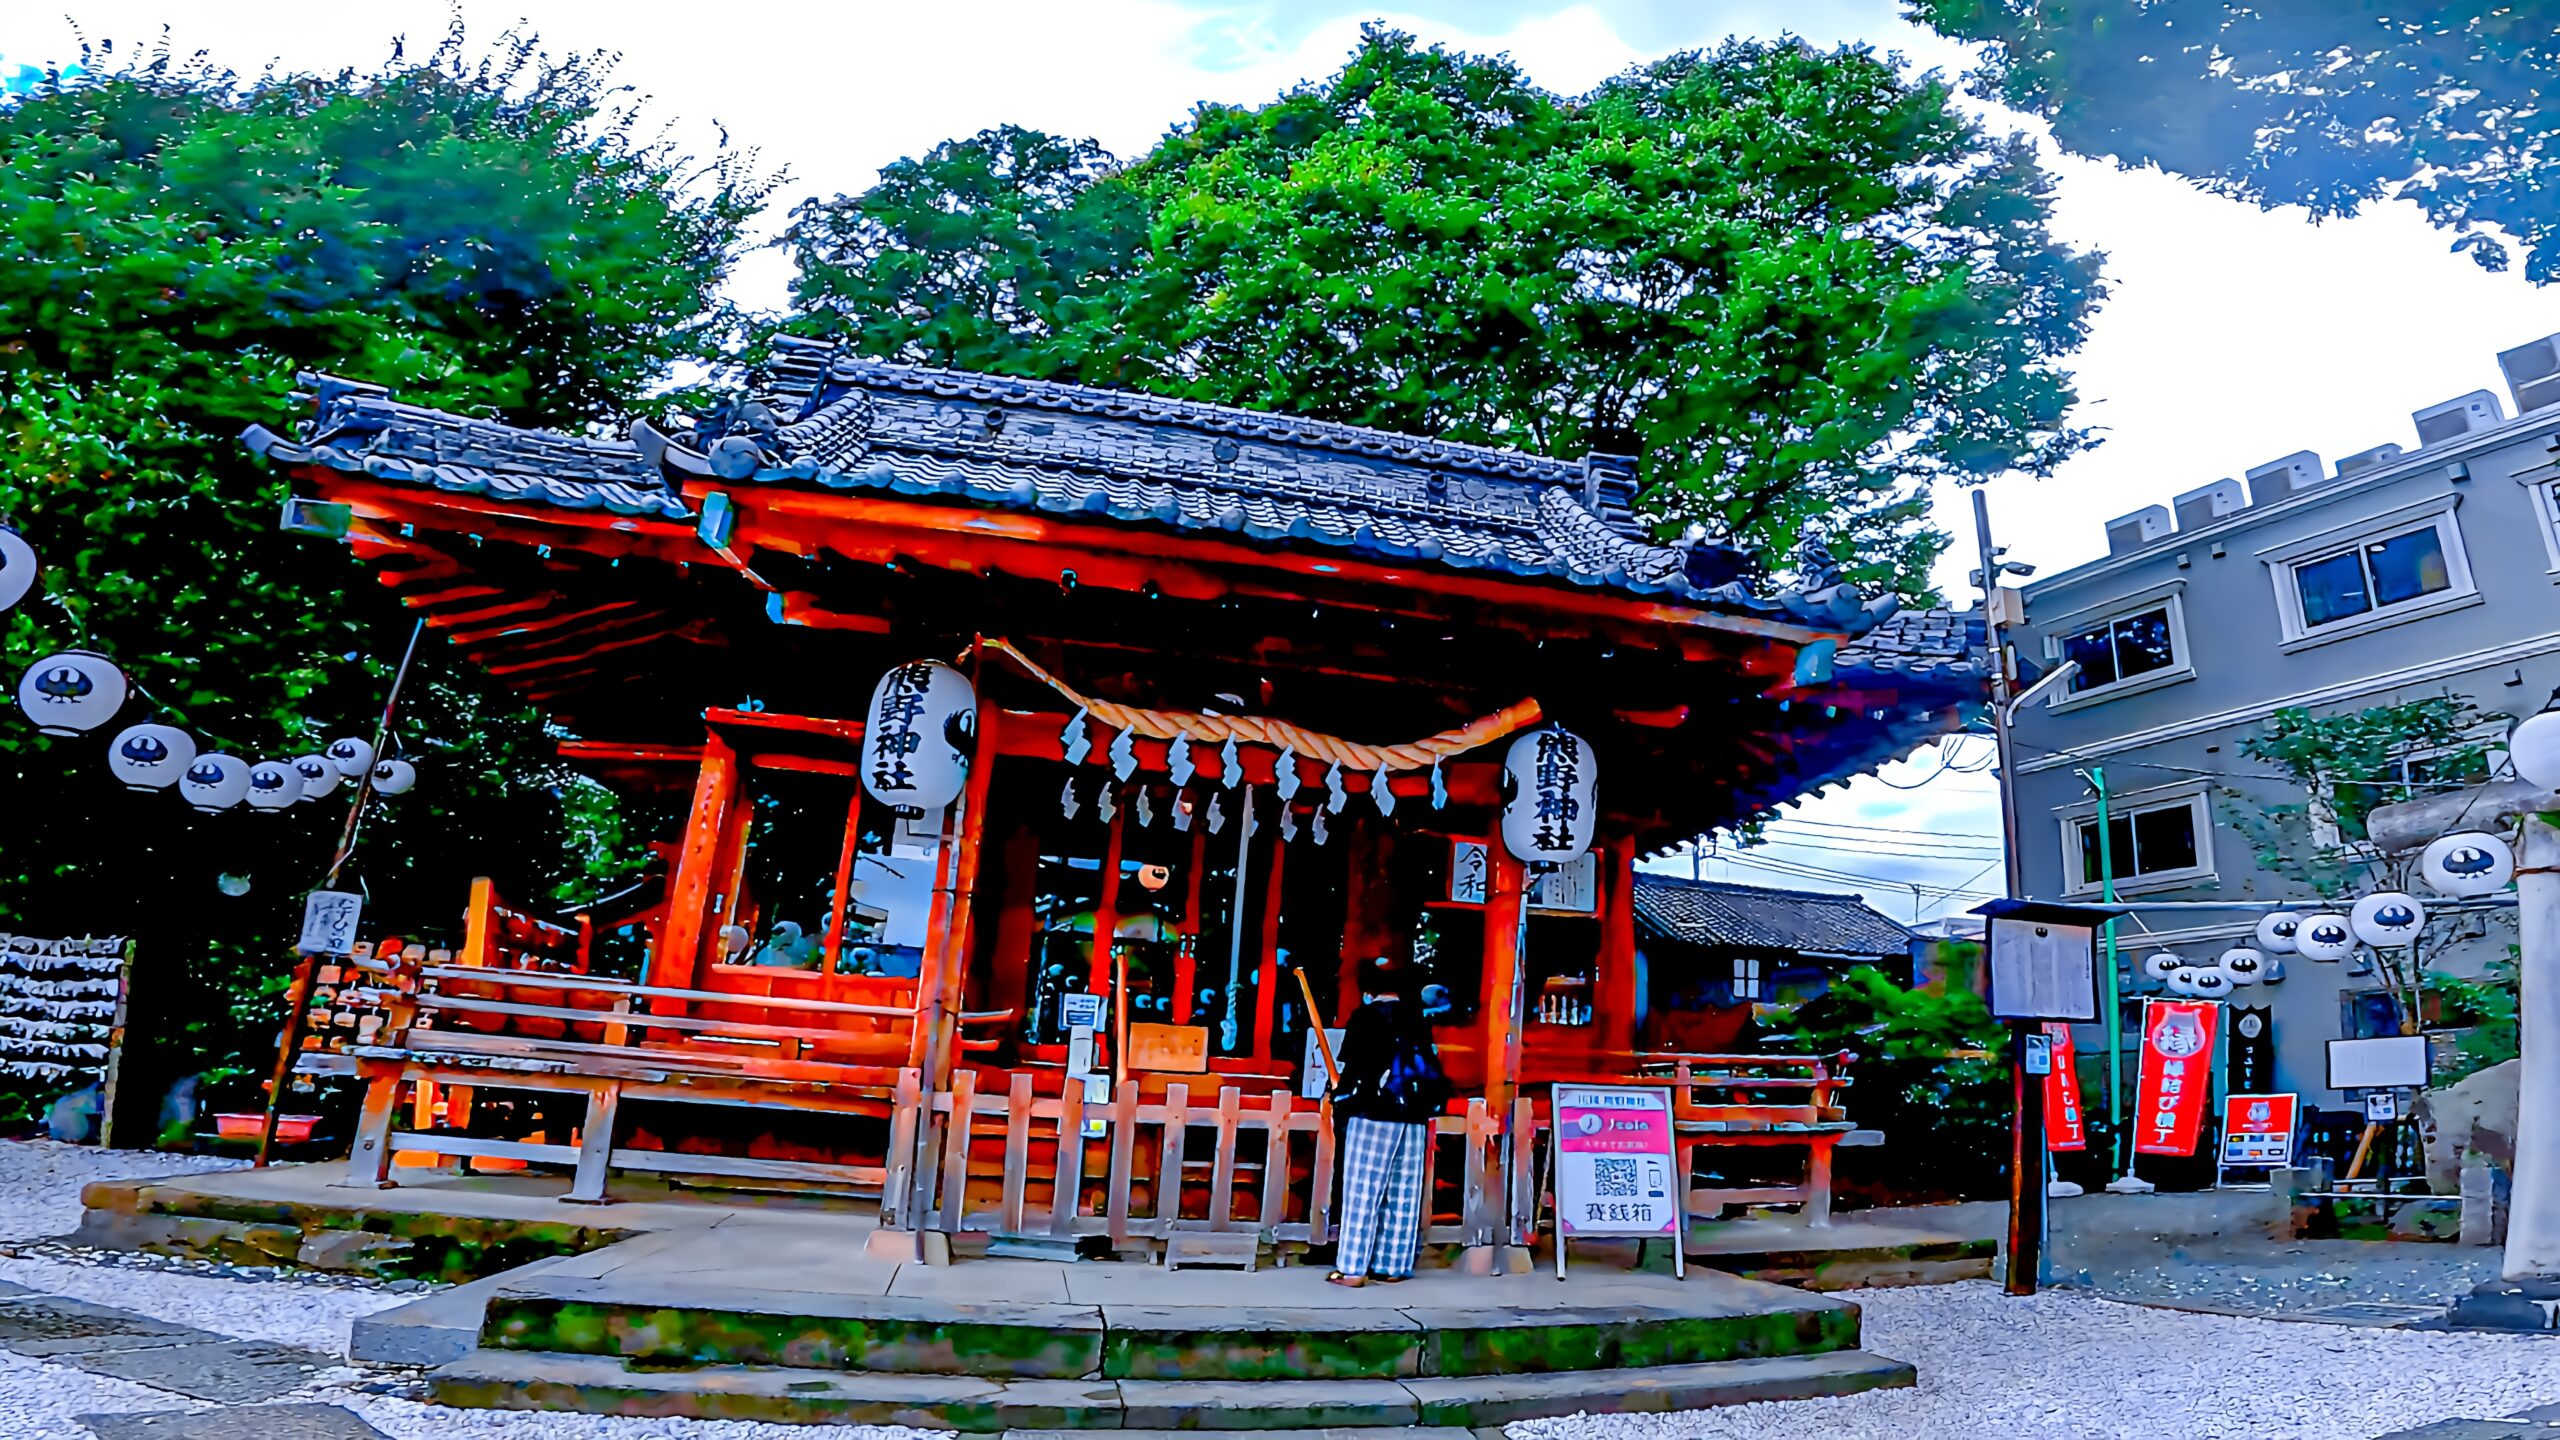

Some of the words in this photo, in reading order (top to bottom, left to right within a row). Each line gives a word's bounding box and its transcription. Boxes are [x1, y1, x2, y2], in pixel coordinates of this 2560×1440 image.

[872, 665, 934, 792] 熊野神社
[1530, 733, 1580, 851] 熊野神社
[1458, 846, 1487, 898] 令和
